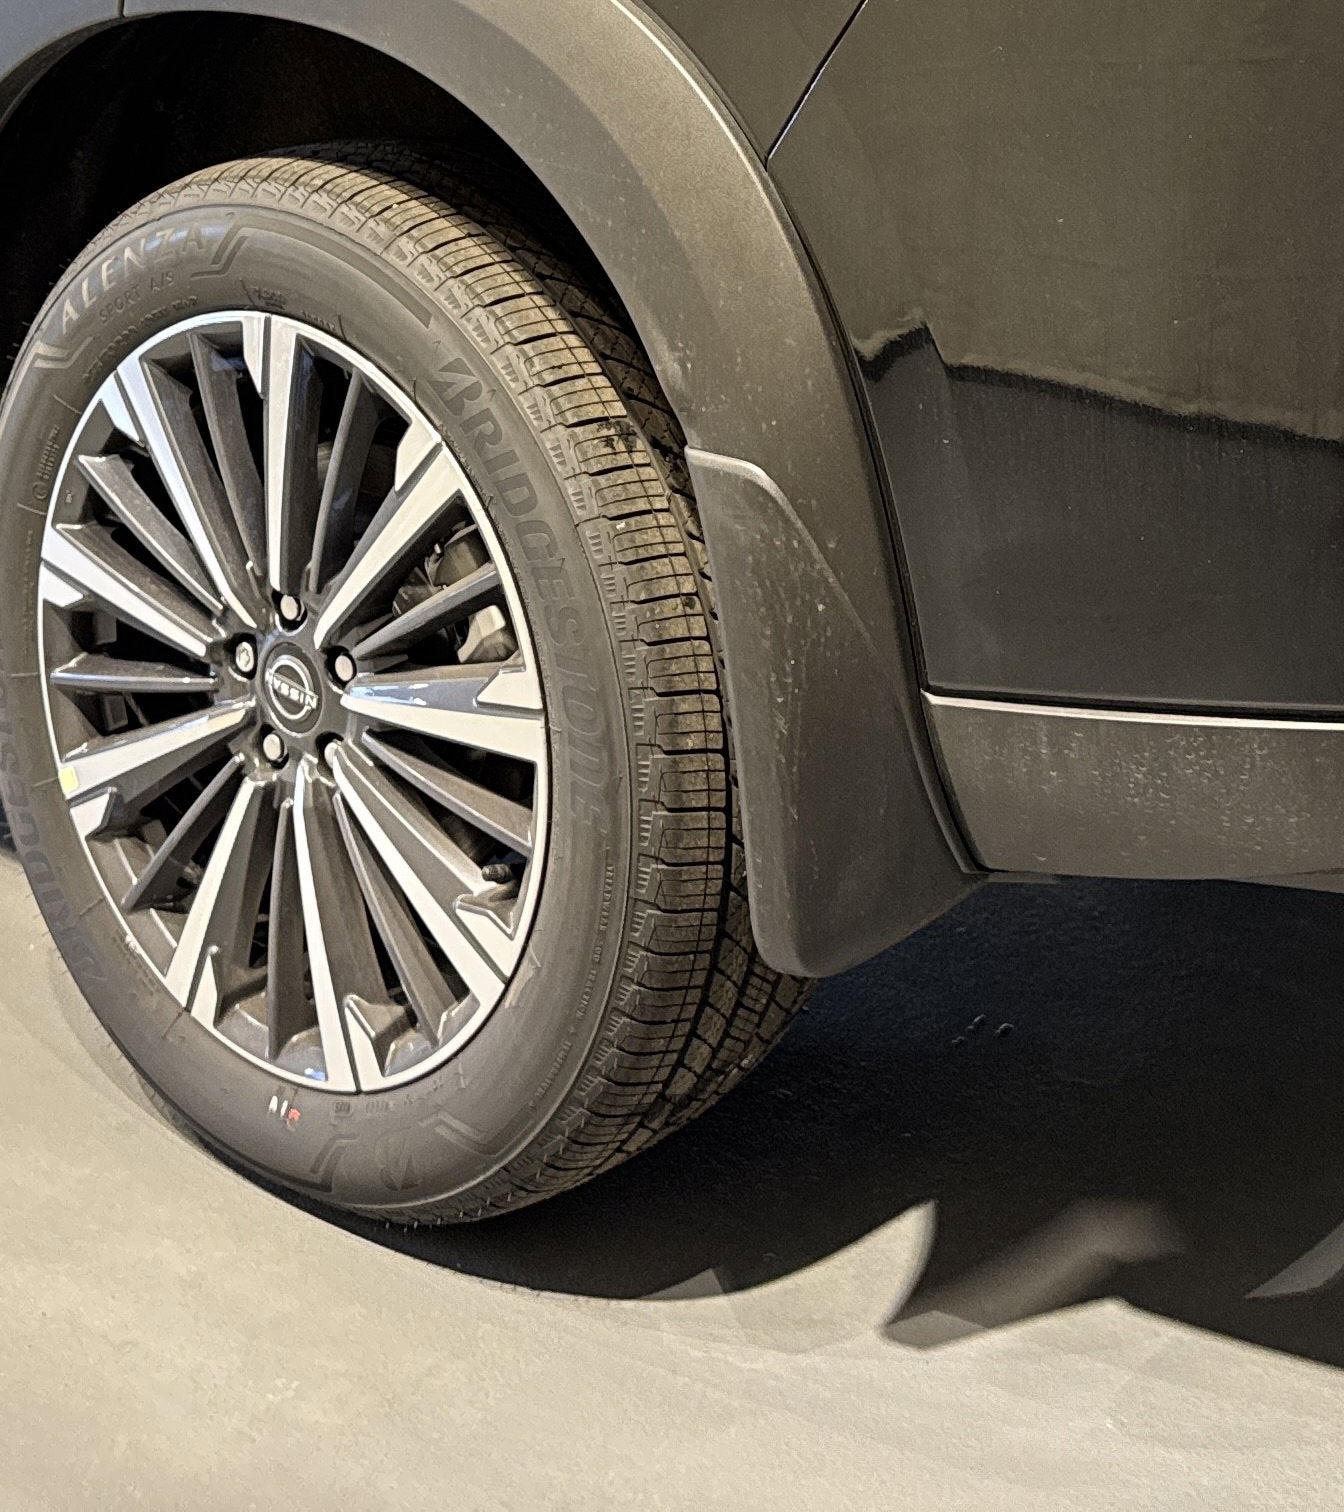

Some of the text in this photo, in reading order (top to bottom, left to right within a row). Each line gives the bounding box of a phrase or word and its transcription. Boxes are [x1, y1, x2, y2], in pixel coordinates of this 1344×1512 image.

[62, 221, 206, 335] ALENZA
[98, 285, 142, 325] SPORT
[430, 355, 609, 836] BRIDGESTONE
